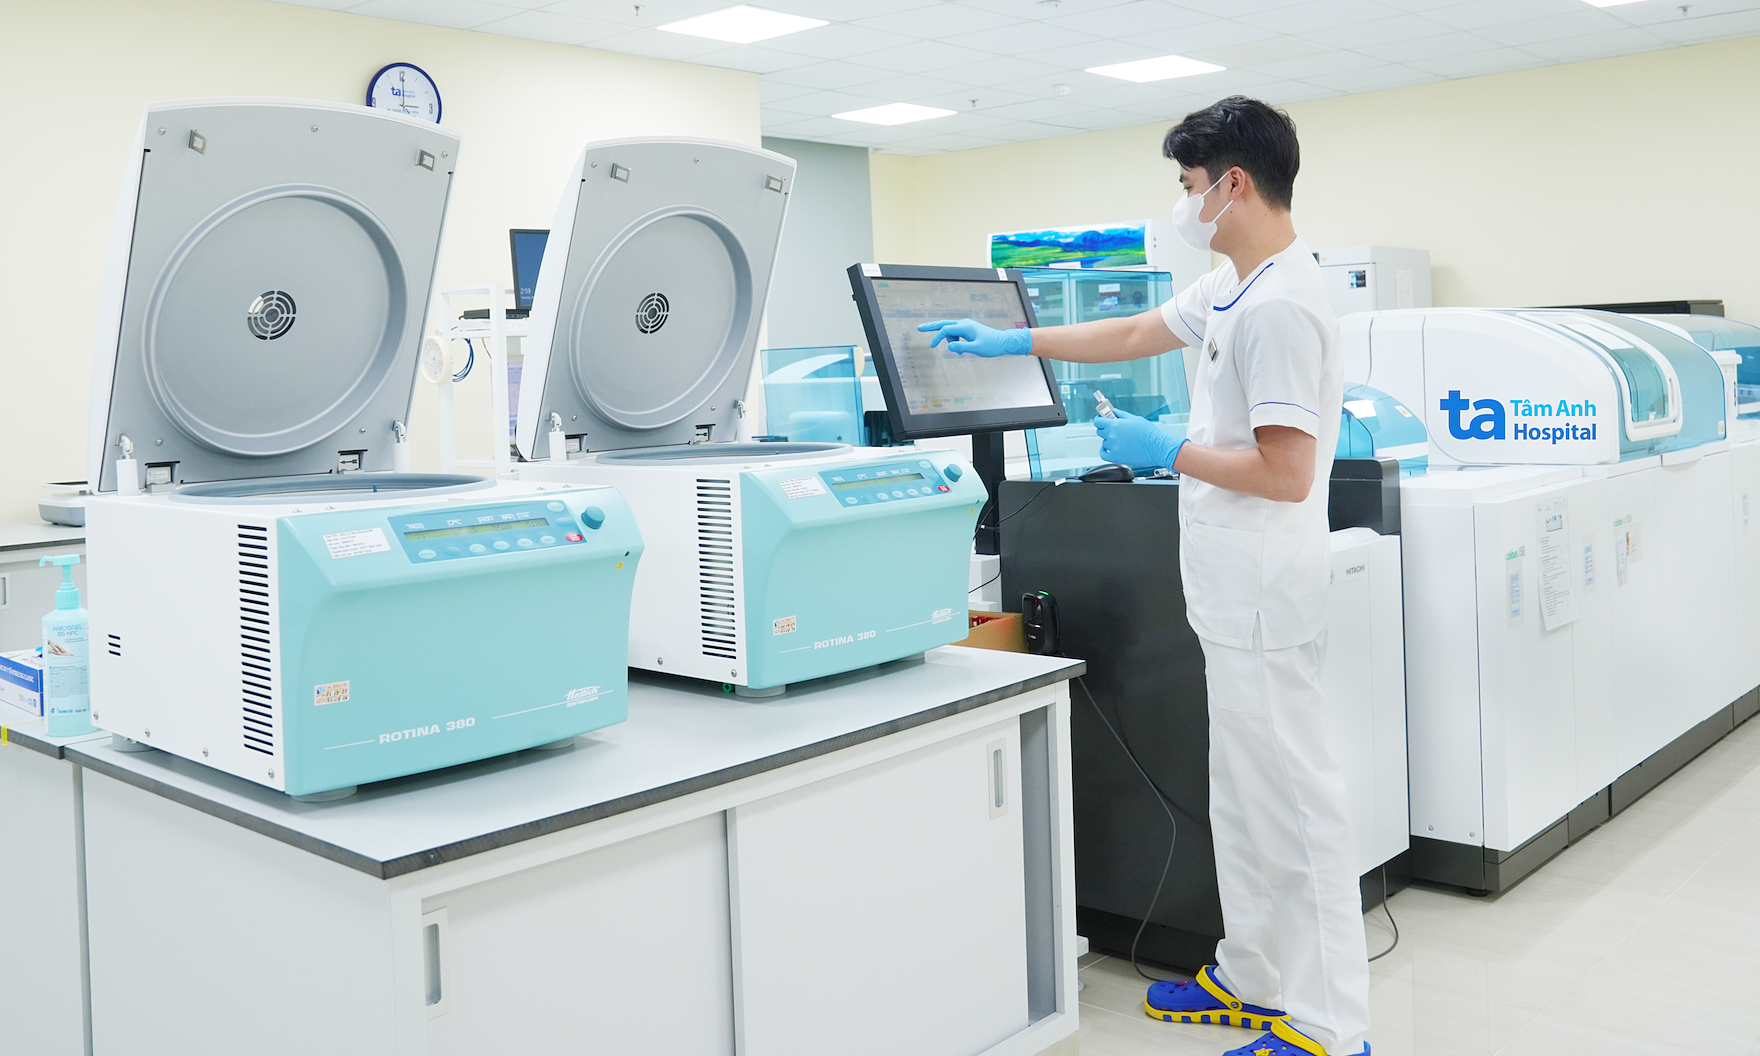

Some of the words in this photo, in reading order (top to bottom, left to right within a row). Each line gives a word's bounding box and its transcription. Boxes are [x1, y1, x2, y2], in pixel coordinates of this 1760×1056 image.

[391, 86, 401, 97] ta
[429, 103, 433, 115] 3
[520, 287, 531, 295] 2:59
[1440, 390, 1506, 440] ta
[1510, 399, 1553, 417] Tâm
[1555, 399, 1597, 417] Anh
[1514, 422, 1597, 445] Hospital
[1345, 564, 1365, 575] HITACHI
[814, 635, 854, 650] ROTINA
[857, 630, 876, 641] 380
[379, 723, 441, 744] ROTINA
[446, 716, 476, 732] 380
